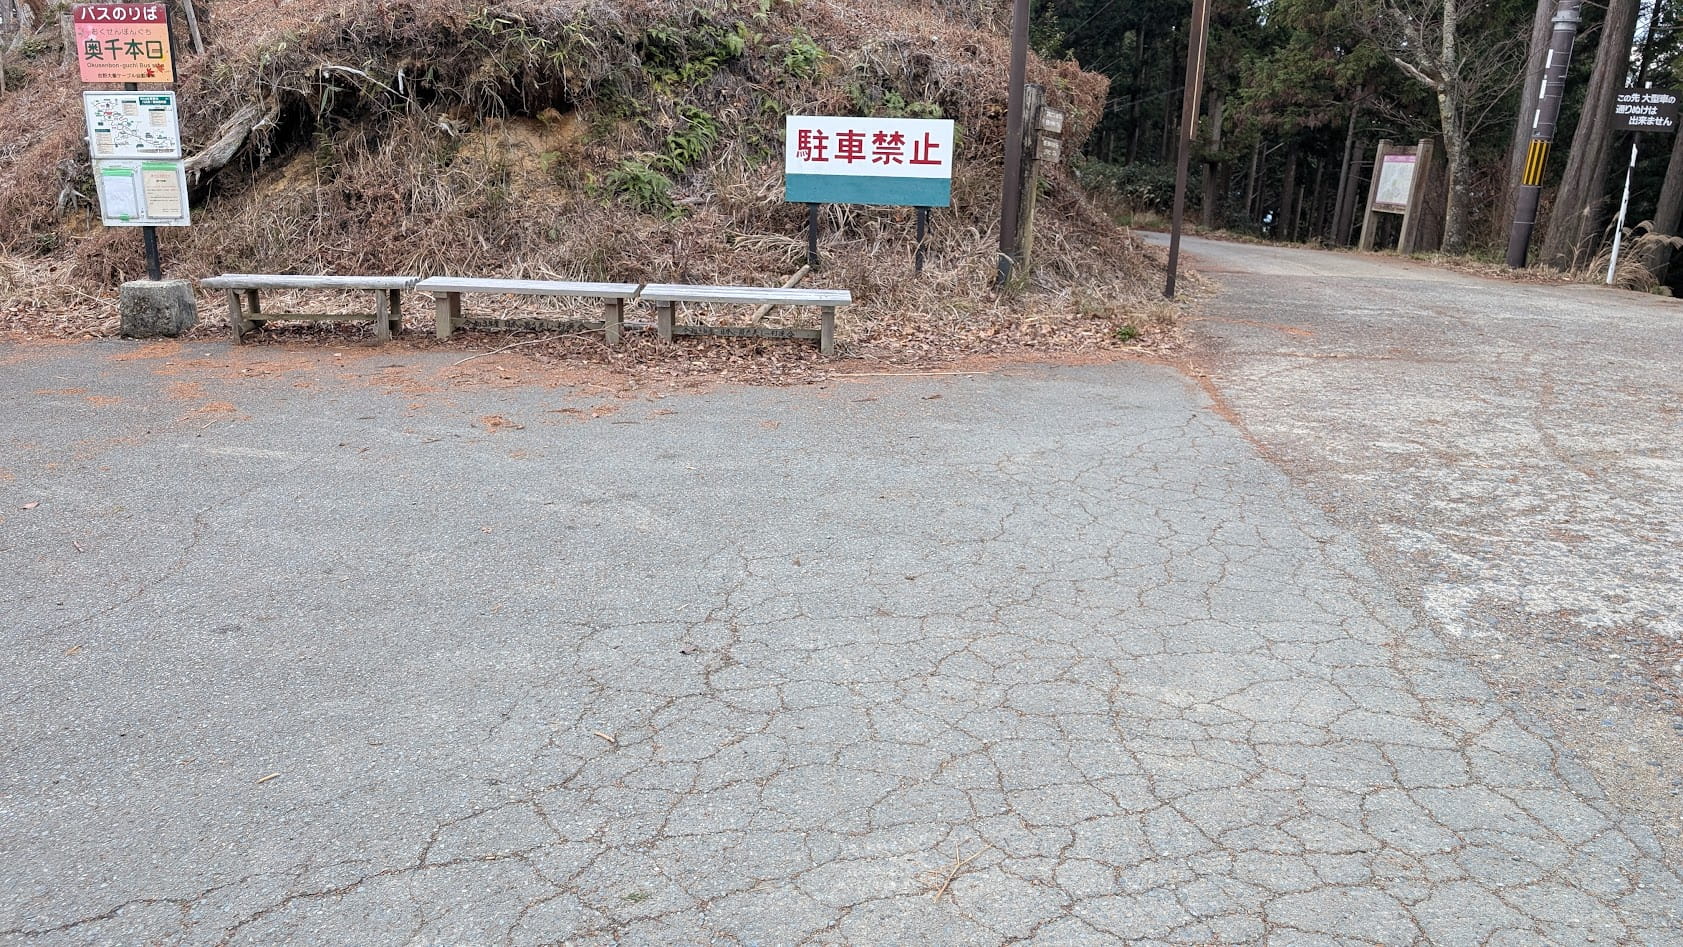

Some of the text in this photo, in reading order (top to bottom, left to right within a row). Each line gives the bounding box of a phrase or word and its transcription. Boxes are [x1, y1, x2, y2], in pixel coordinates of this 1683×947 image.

[81, 6, 158, 20] バスのりば
[84, 38, 164, 61] 奥千本口
[1617, 93, 1676, 104] この先 大型車の
[1615, 104, 1659, 115] 通りぬけは
[1628, 115, 1673, 127] 出来ません
[796, 128, 942, 166] 駐車禁止
